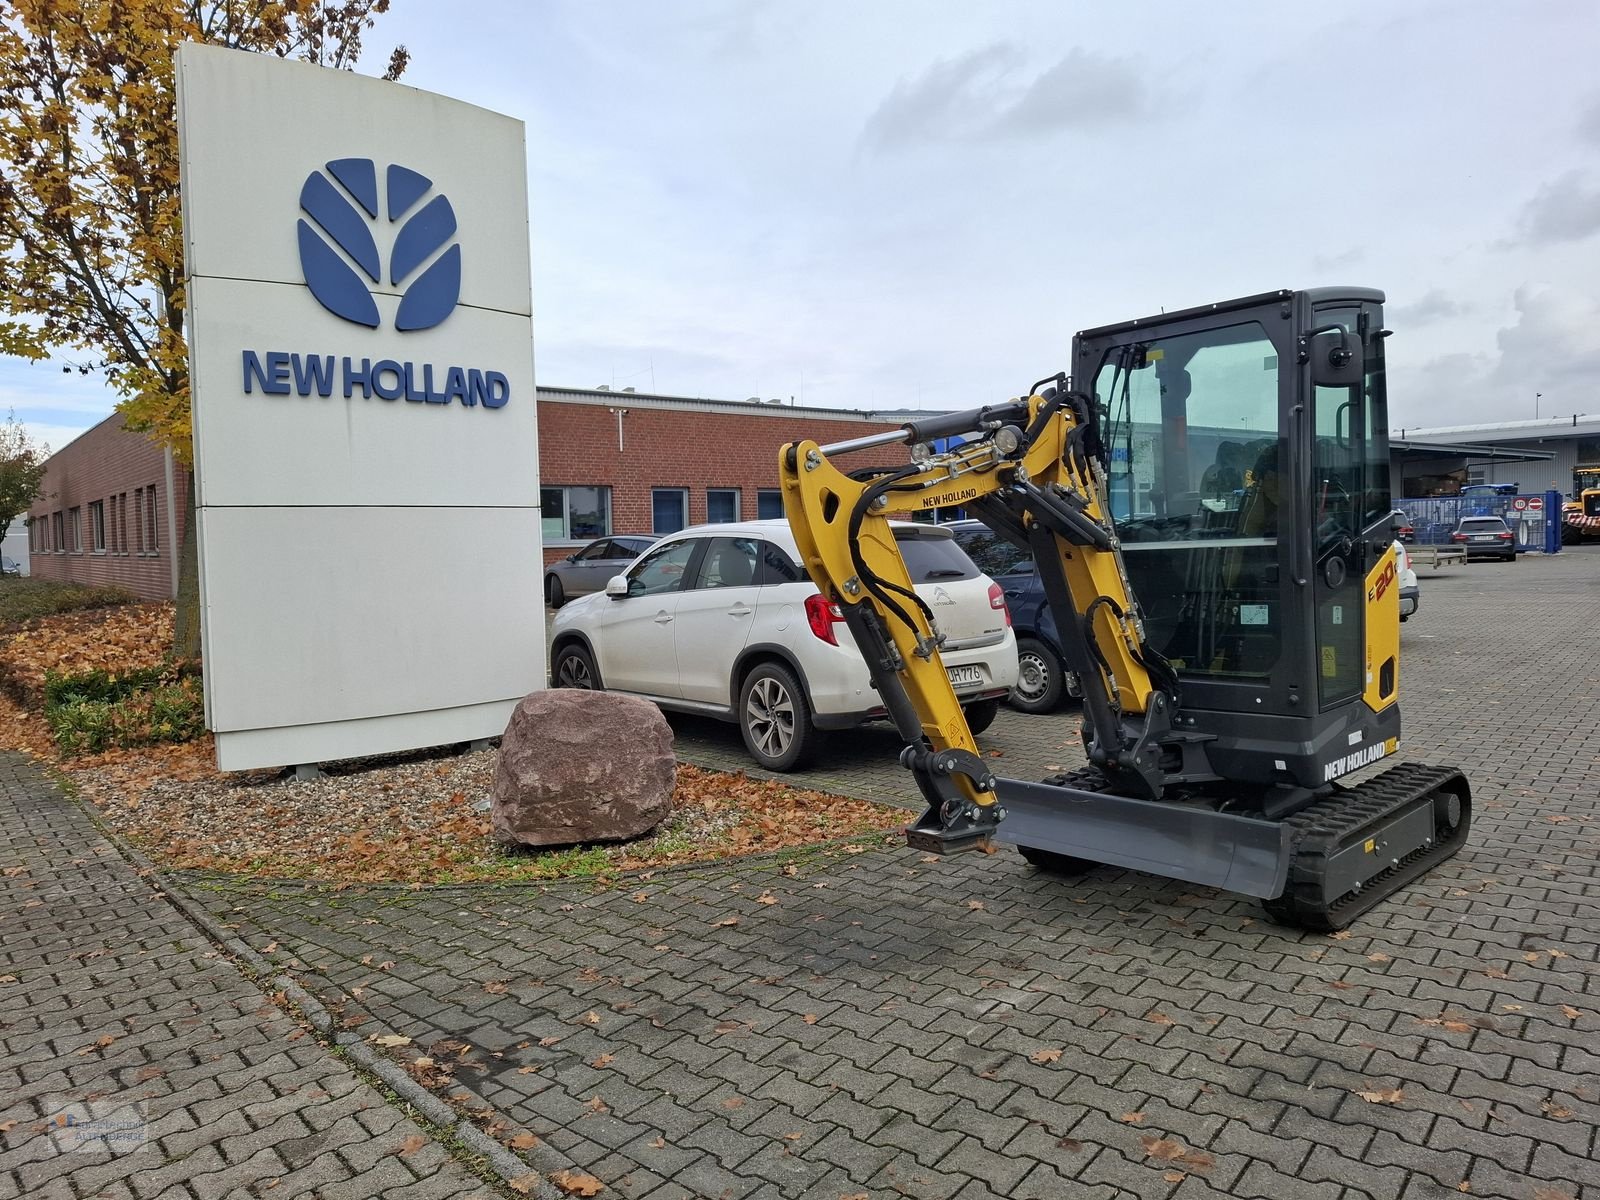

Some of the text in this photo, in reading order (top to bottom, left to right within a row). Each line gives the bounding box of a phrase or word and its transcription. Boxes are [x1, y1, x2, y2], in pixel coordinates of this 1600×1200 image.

[242, 350, 511, 409] NEW HOLLAND
[922, 488, 977, 508] NEW HOLLAND
[960, 666, 980, 682] 776
[1324, 757, 1347, 782] NEW
[1347, 741, 1385, 772] HOLLAND
